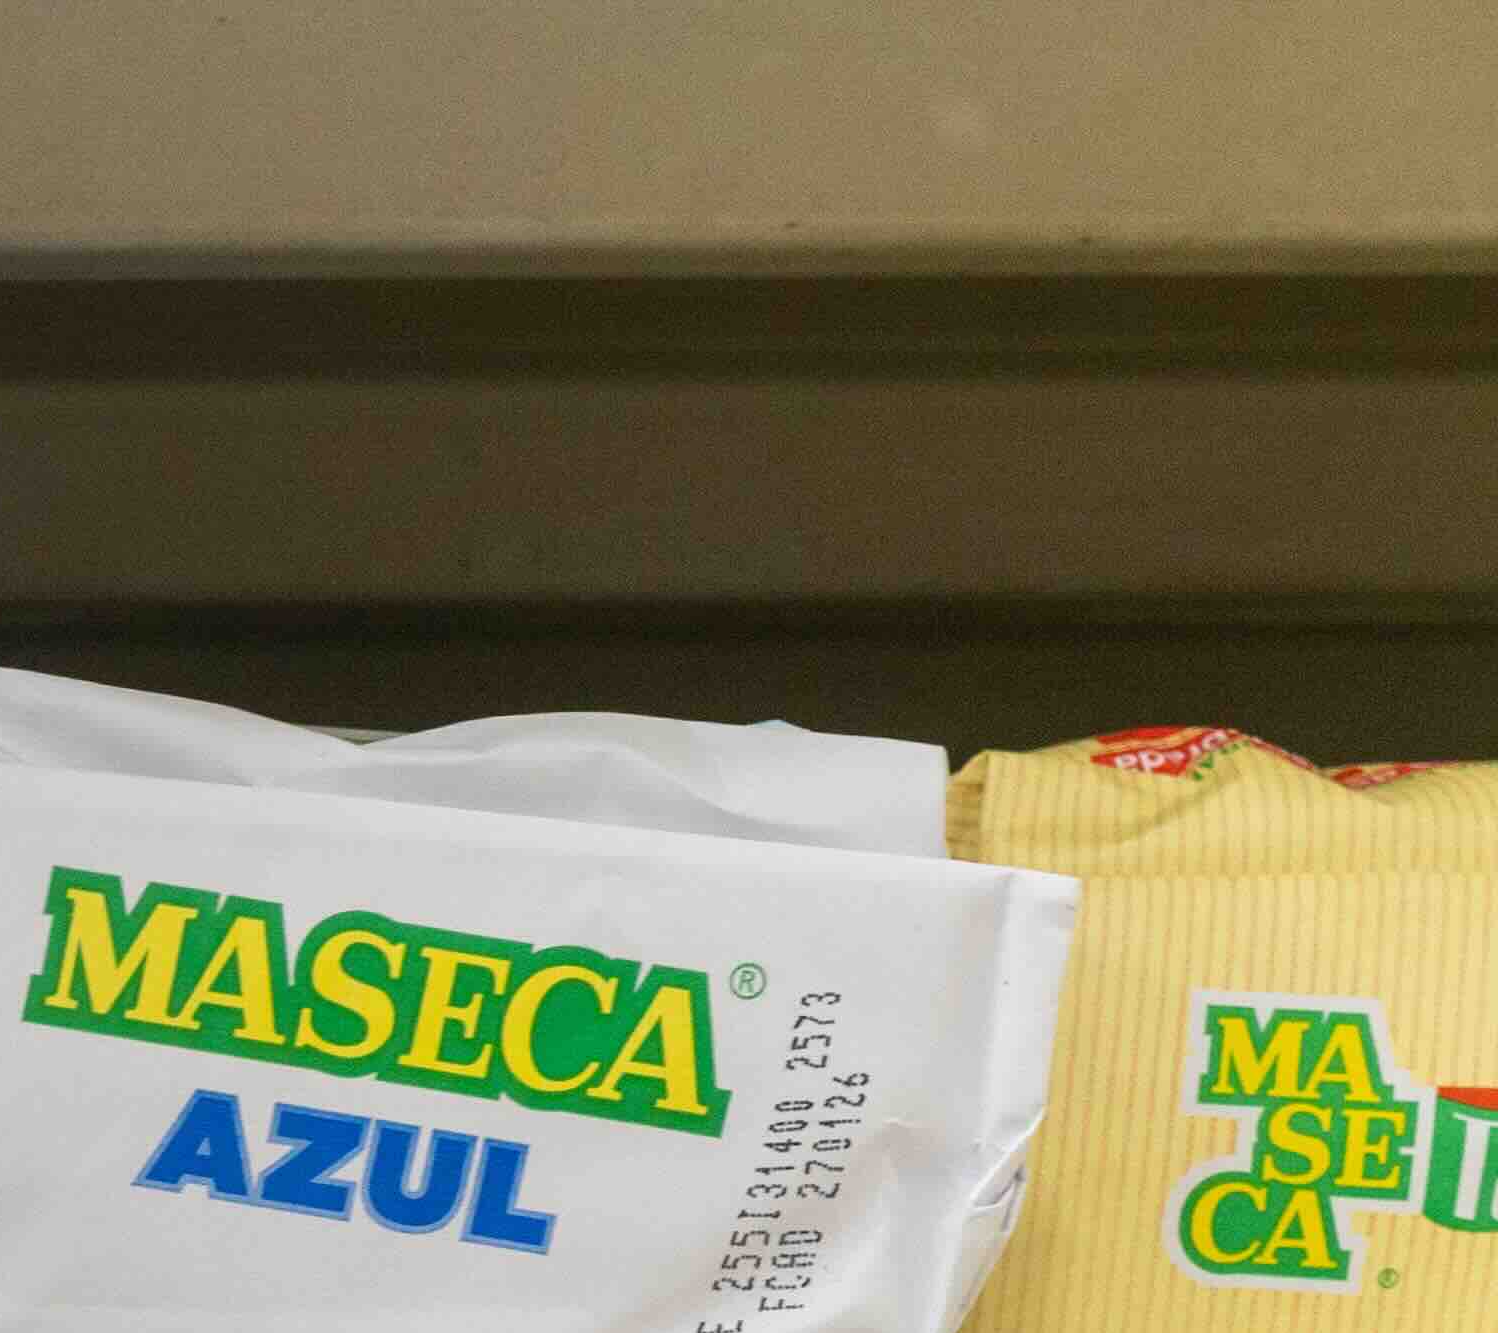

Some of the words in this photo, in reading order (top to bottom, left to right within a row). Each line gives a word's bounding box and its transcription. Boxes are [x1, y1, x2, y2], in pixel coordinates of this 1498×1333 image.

[43, 889, 710, 1120] MASECA
[784, 992, 841, 1069] 2573
[1210, 1018, 1379, 1103] MA
[130, 1087, 557, 1255] AZUL
[797, 1072, 869, 1198] 270126
[1262, 1103, 1406, 1189] SE
[1190, 1182, 1339, 1269] CA
